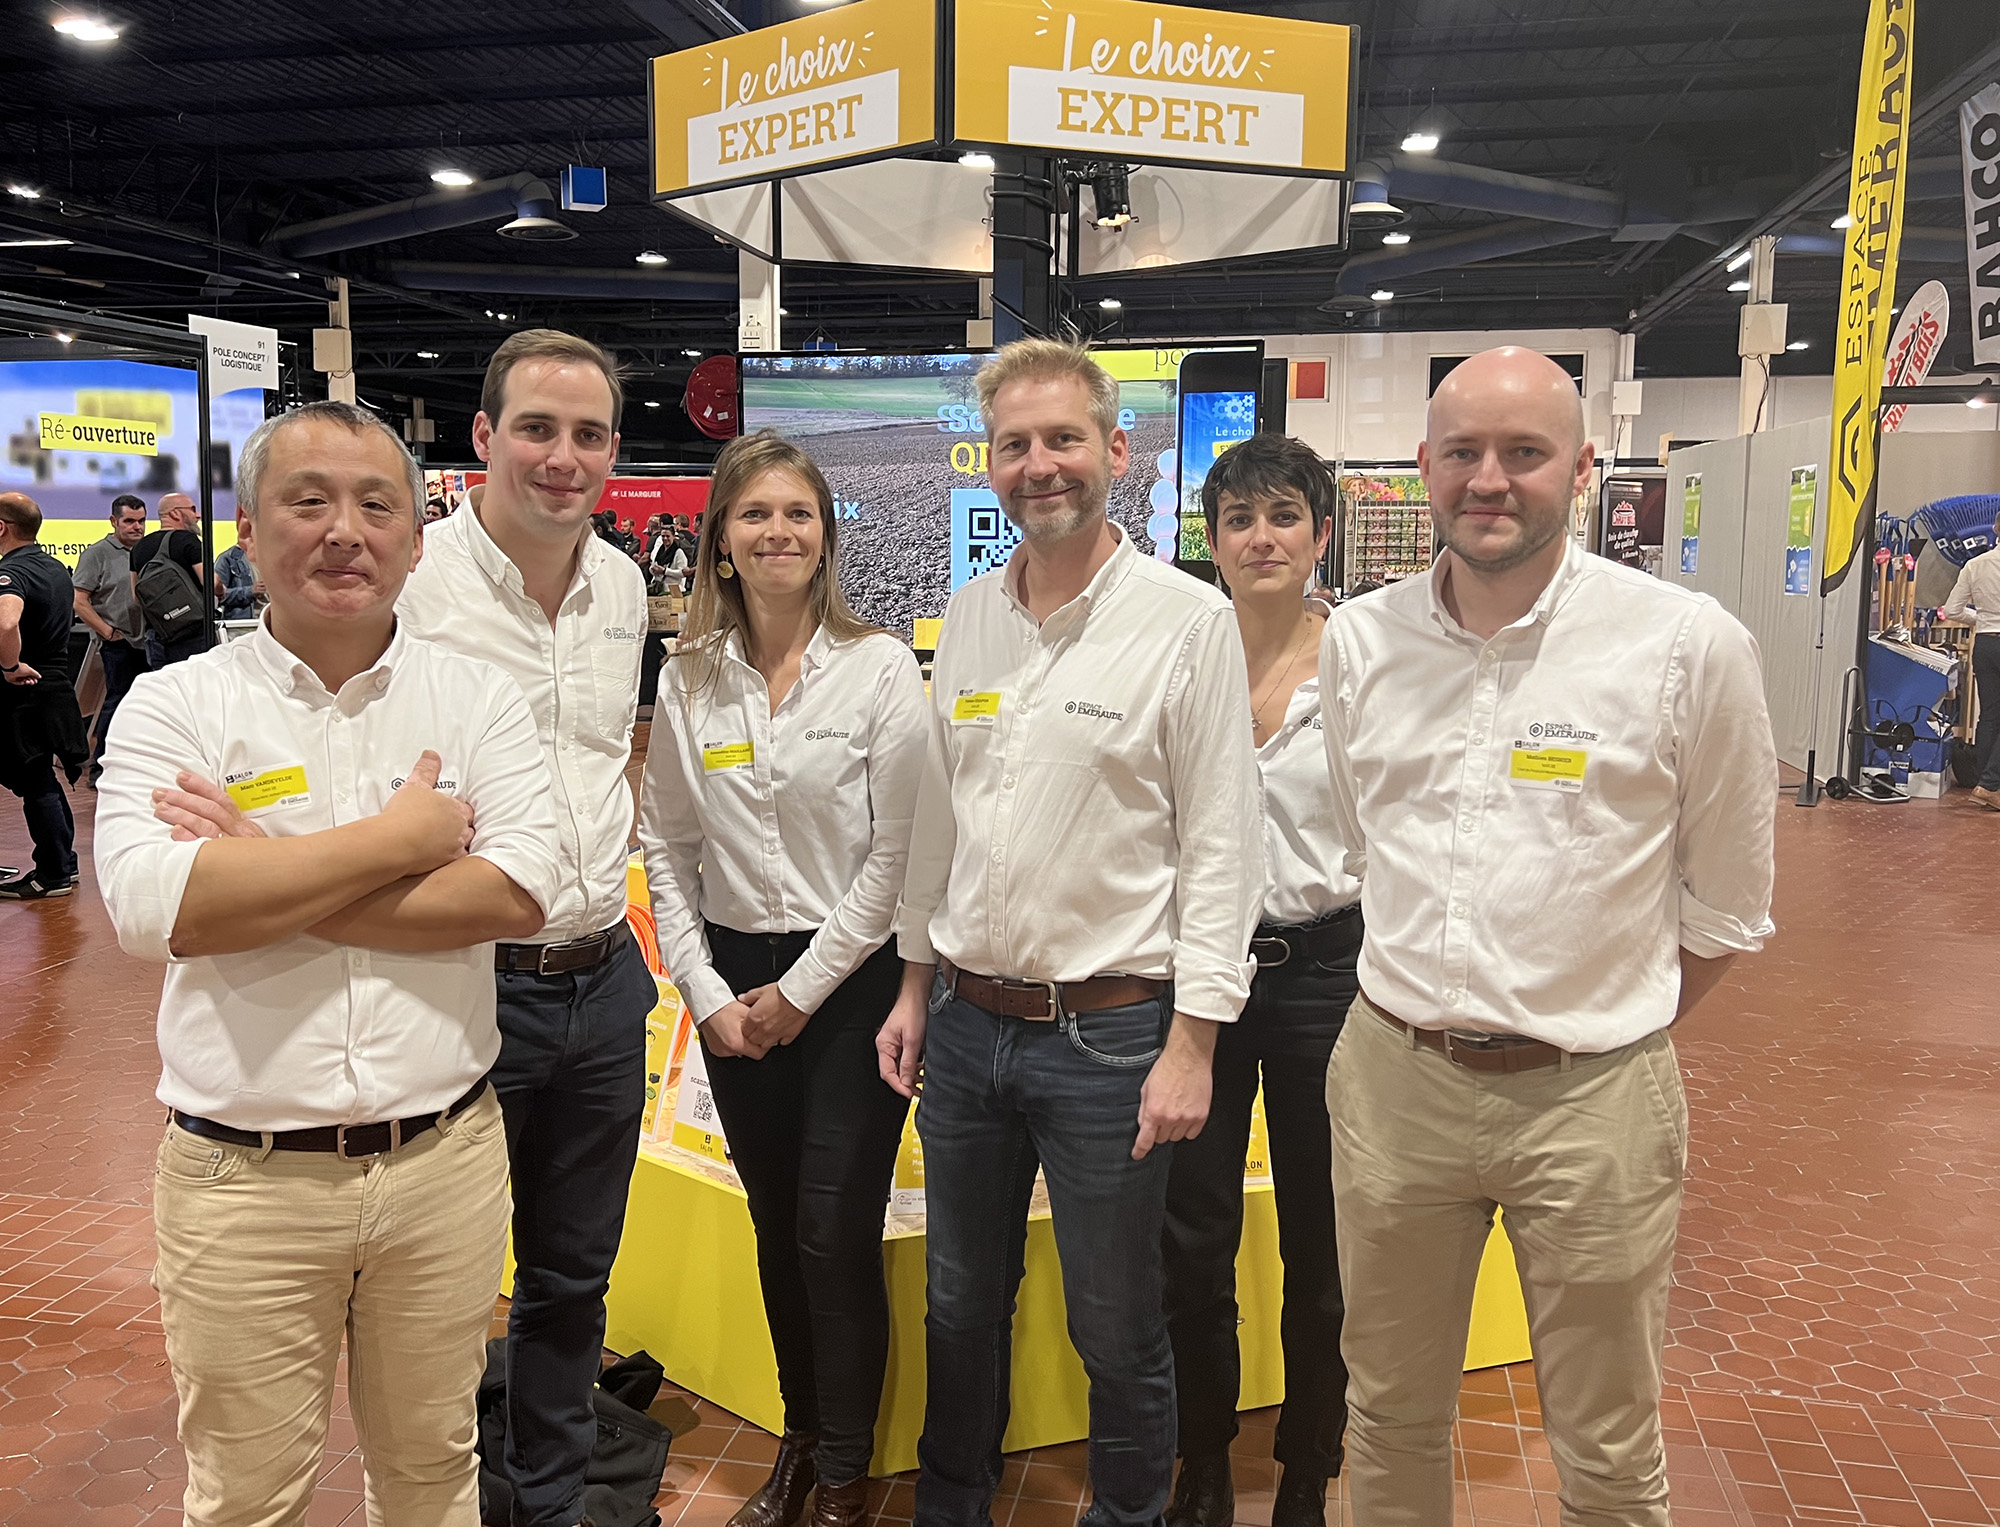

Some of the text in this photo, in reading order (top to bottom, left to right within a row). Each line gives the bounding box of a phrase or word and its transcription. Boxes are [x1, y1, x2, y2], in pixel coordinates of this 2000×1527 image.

[1062, 13, 1251, 79] Le choix
[720, 35, 855, 111] Le choix
[1056, 86, 1259, 147] EXPERT
[717, 93, 863, 165] EXPERT
[1970, 112, 2000, 341] BAHCO
[1845, 150, 1874, 368] ESPACE
[213, 347, 231, 357] POLE
[232, 350, 265, 362] CONCEPT
[257, 341, 265, 349] 91
[221, 358, 262, 372] LOGISTIQUE
[1153, 347, 1185, 371] po
[40, 417, 155, 446] Ré-ouverture
[1215, 426, 1228, 437] Le
[620, 490, 627, 498] LE
[833, 493, 860, 520] ix
[1078, 707, 1123, 721] EMERAUDE
[1545, 729, 1598, 741] EMERAUDE
[1245, 1160, 1263, 1170] LON
